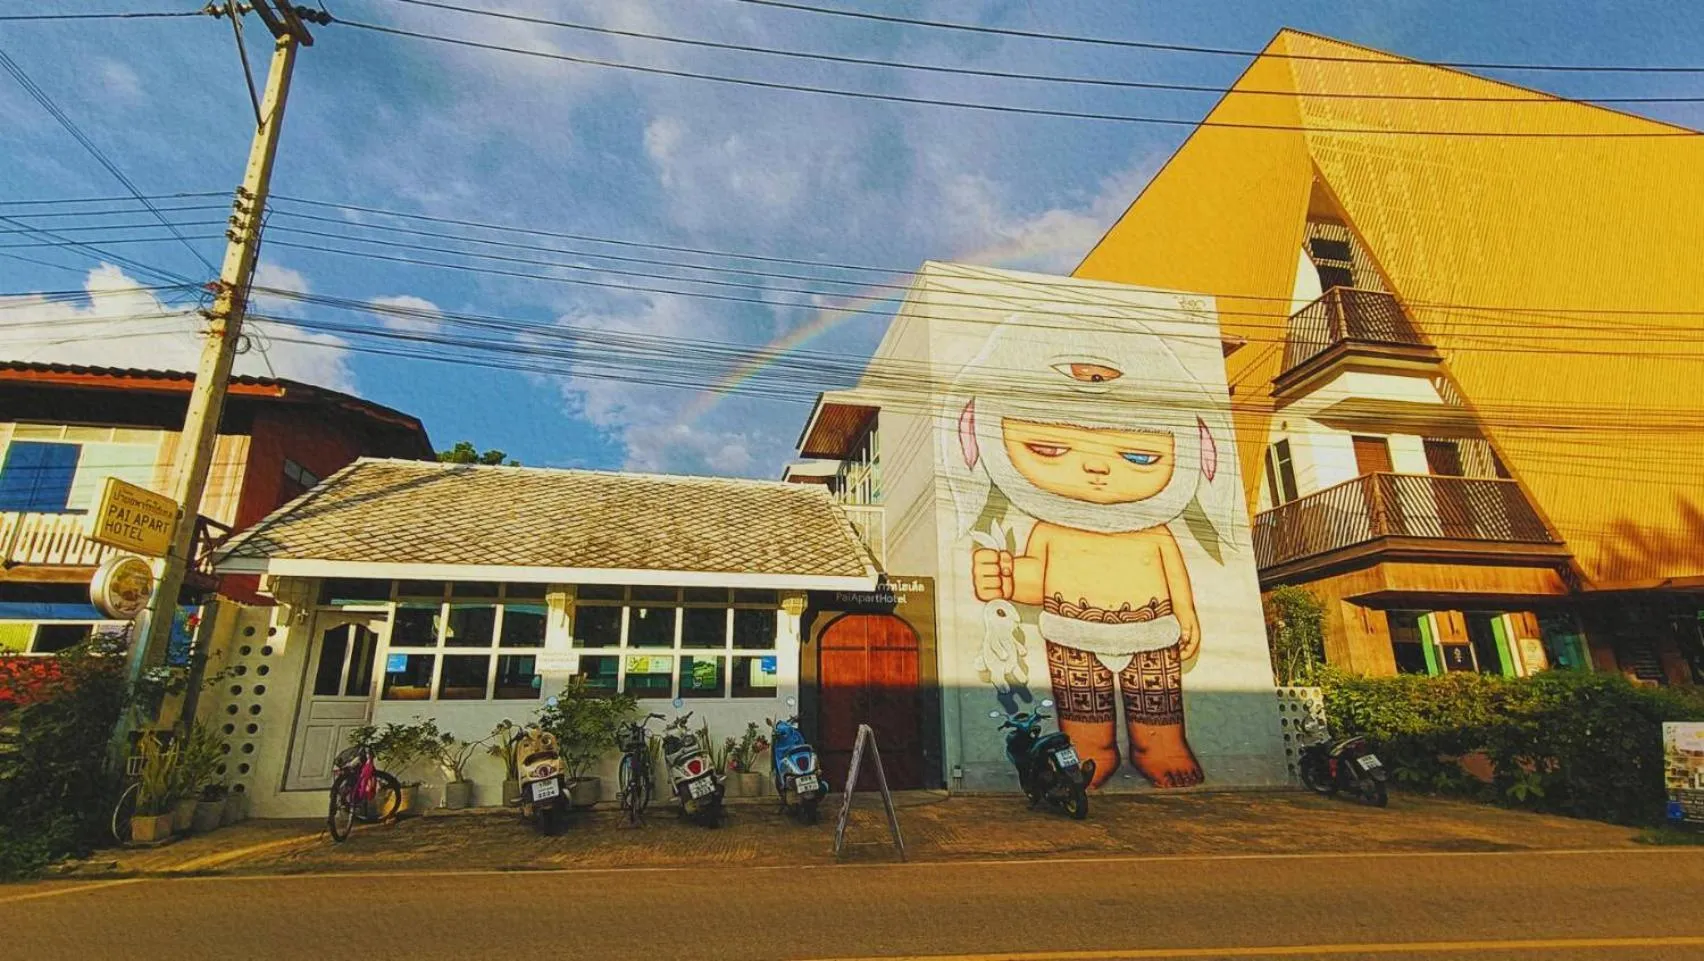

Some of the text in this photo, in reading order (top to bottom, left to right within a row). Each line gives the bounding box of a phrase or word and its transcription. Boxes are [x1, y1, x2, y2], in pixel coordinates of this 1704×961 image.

[108, 504, 131, 522] PAI
[132, 513, 170, 533] APART
[105, 521, 144, 541] HOTEL
